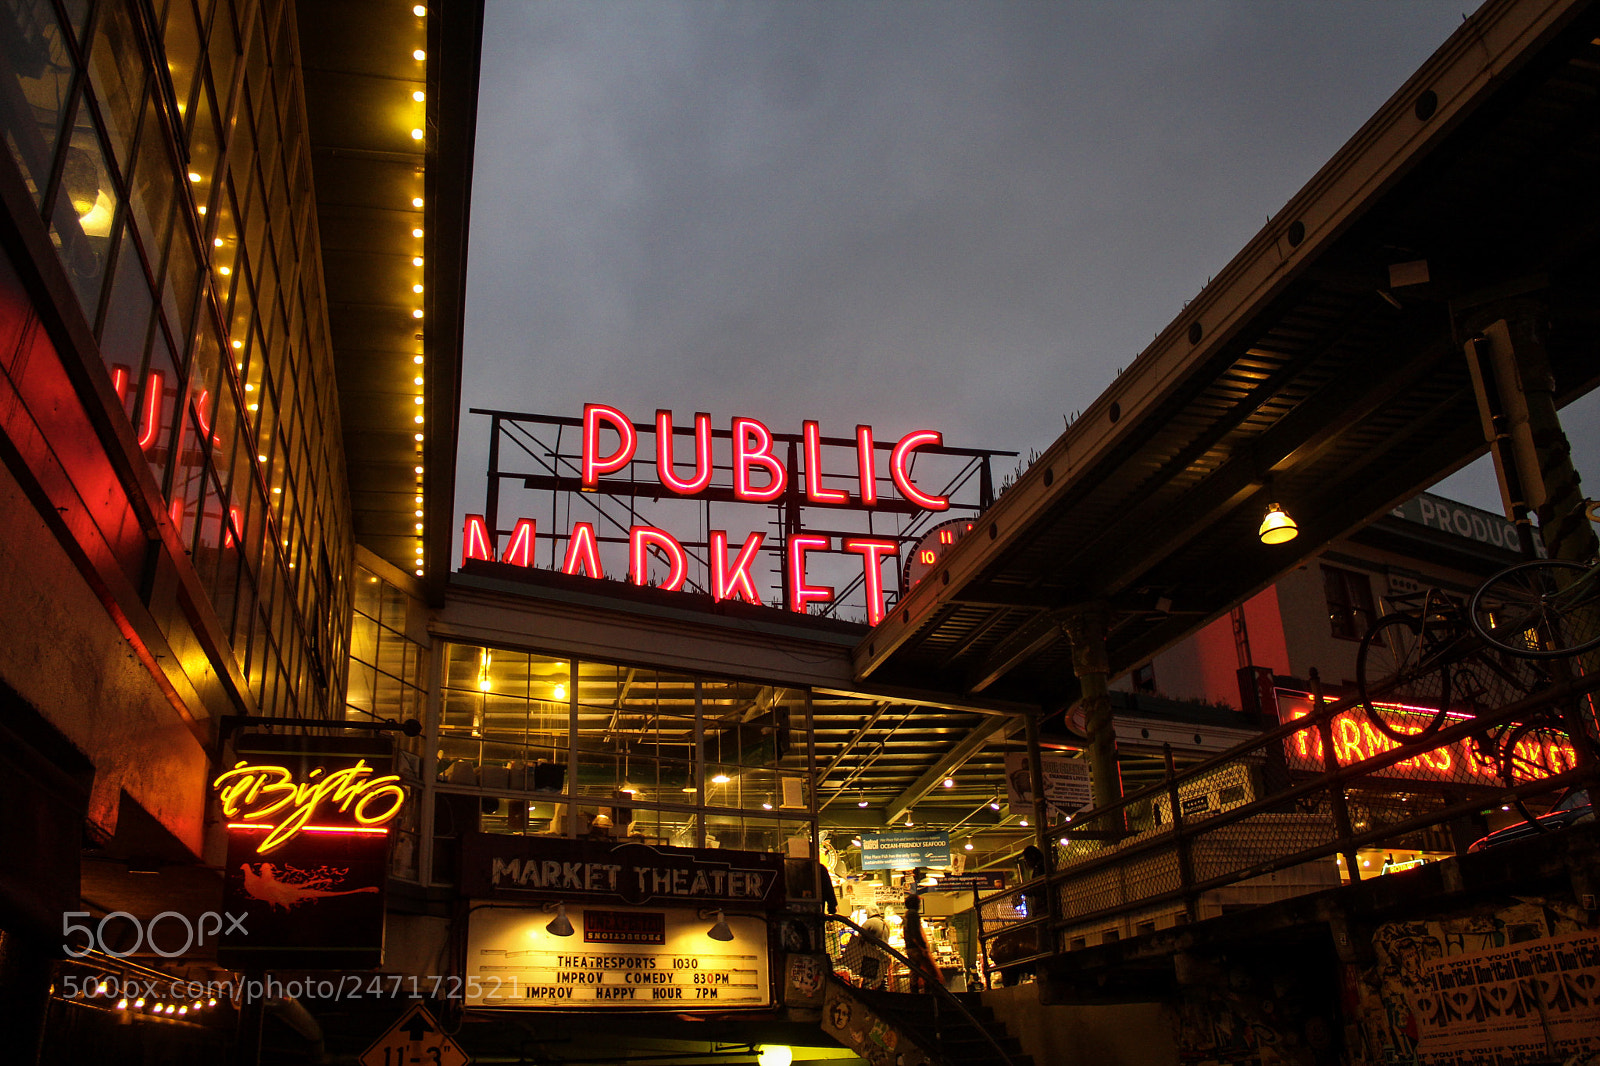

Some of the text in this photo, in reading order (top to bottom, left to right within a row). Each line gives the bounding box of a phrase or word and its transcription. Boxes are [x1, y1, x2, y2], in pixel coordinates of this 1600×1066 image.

[582, 403, 949, 511] PUBLIC
[940, 530, 953, 545] 11
[920, 550, 936, 565] 10
[880, 840, 947, 850] OCEAN-FRIENDLY SEAFOOD
[492, 858, 764, 898] MARKET THEATER
[587, 932, 662, 942] PRODUCTIONS
[557, 956, 698, 969] THEATRESPORTS 1030
[557, 972, 729, 985] IMPROV COMEDY 830PM
[526, 987, 719, 999] IMPROV HAPPY HOUR 7PM
